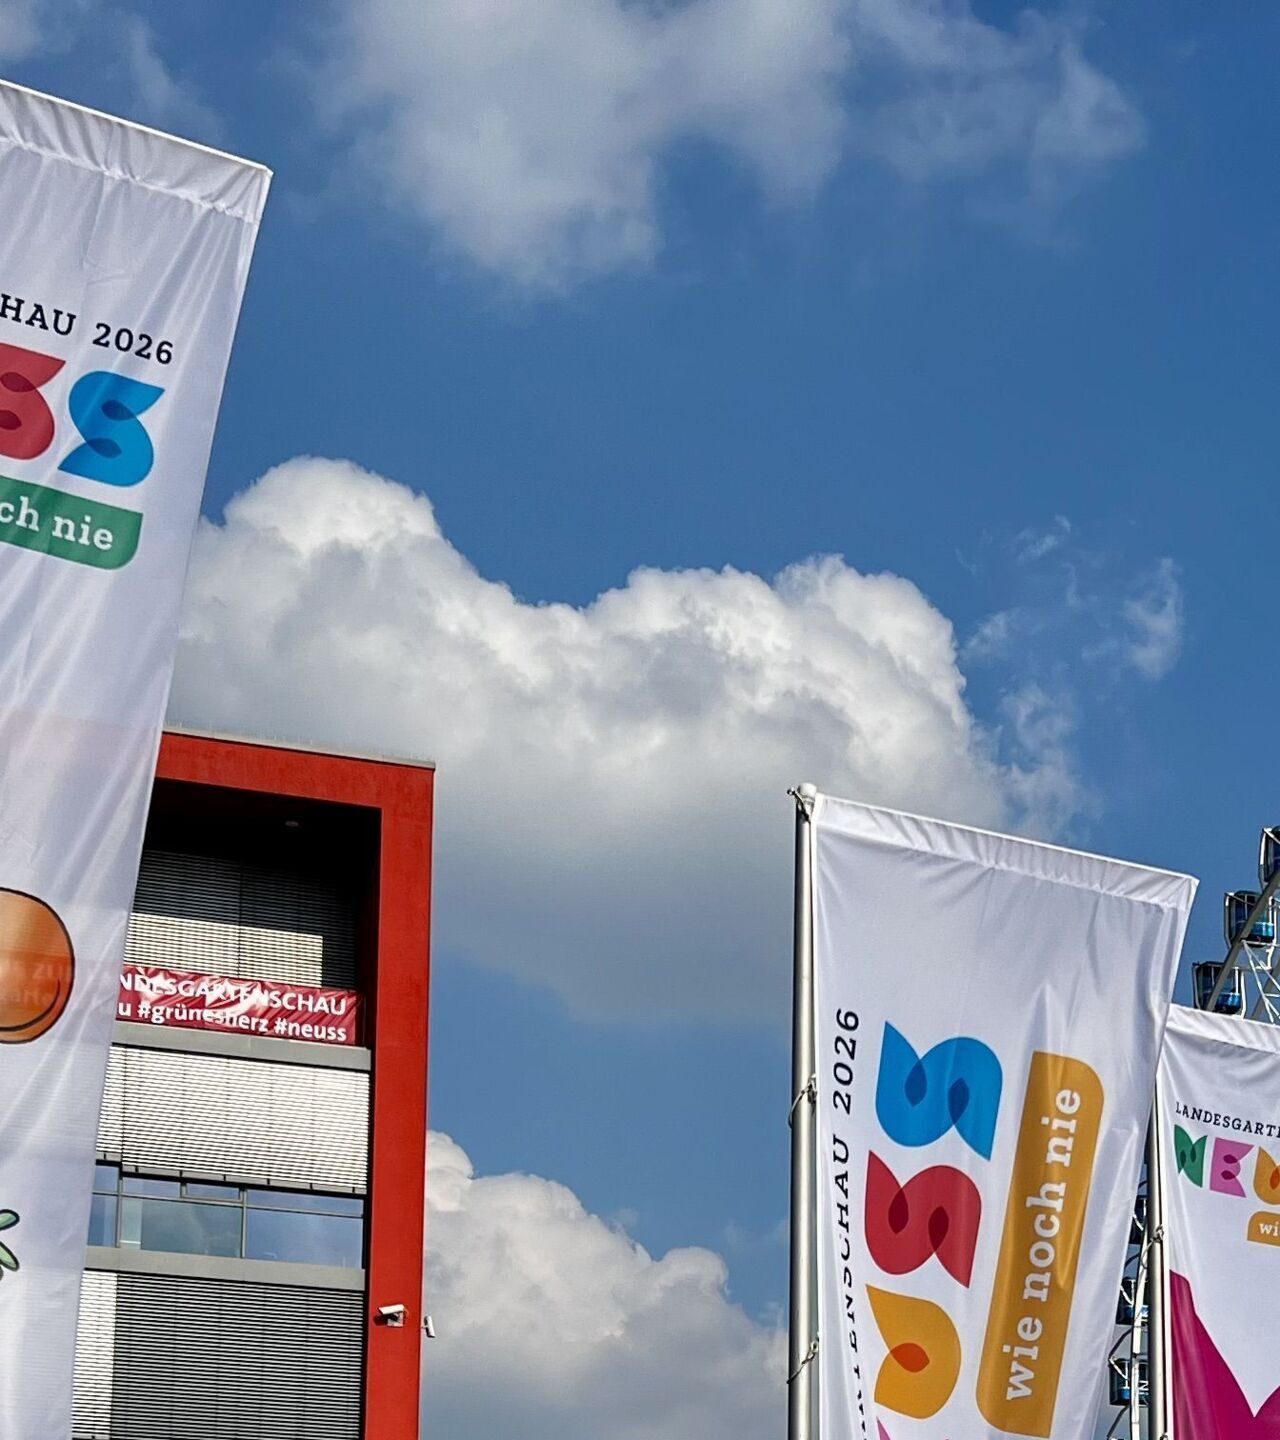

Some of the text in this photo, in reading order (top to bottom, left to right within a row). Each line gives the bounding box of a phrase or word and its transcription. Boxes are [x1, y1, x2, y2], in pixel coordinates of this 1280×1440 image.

[92, 321, 175, 366] 2026
[51, 513, 115, 553] nie
[136, 1000, 269, 1034] #grünesherz
[273, 1017, 348, 1042] #neuss
[832, 1007, 860, 1115] 2026
[1004, 1087, 1083, 1401] wie noch nie
